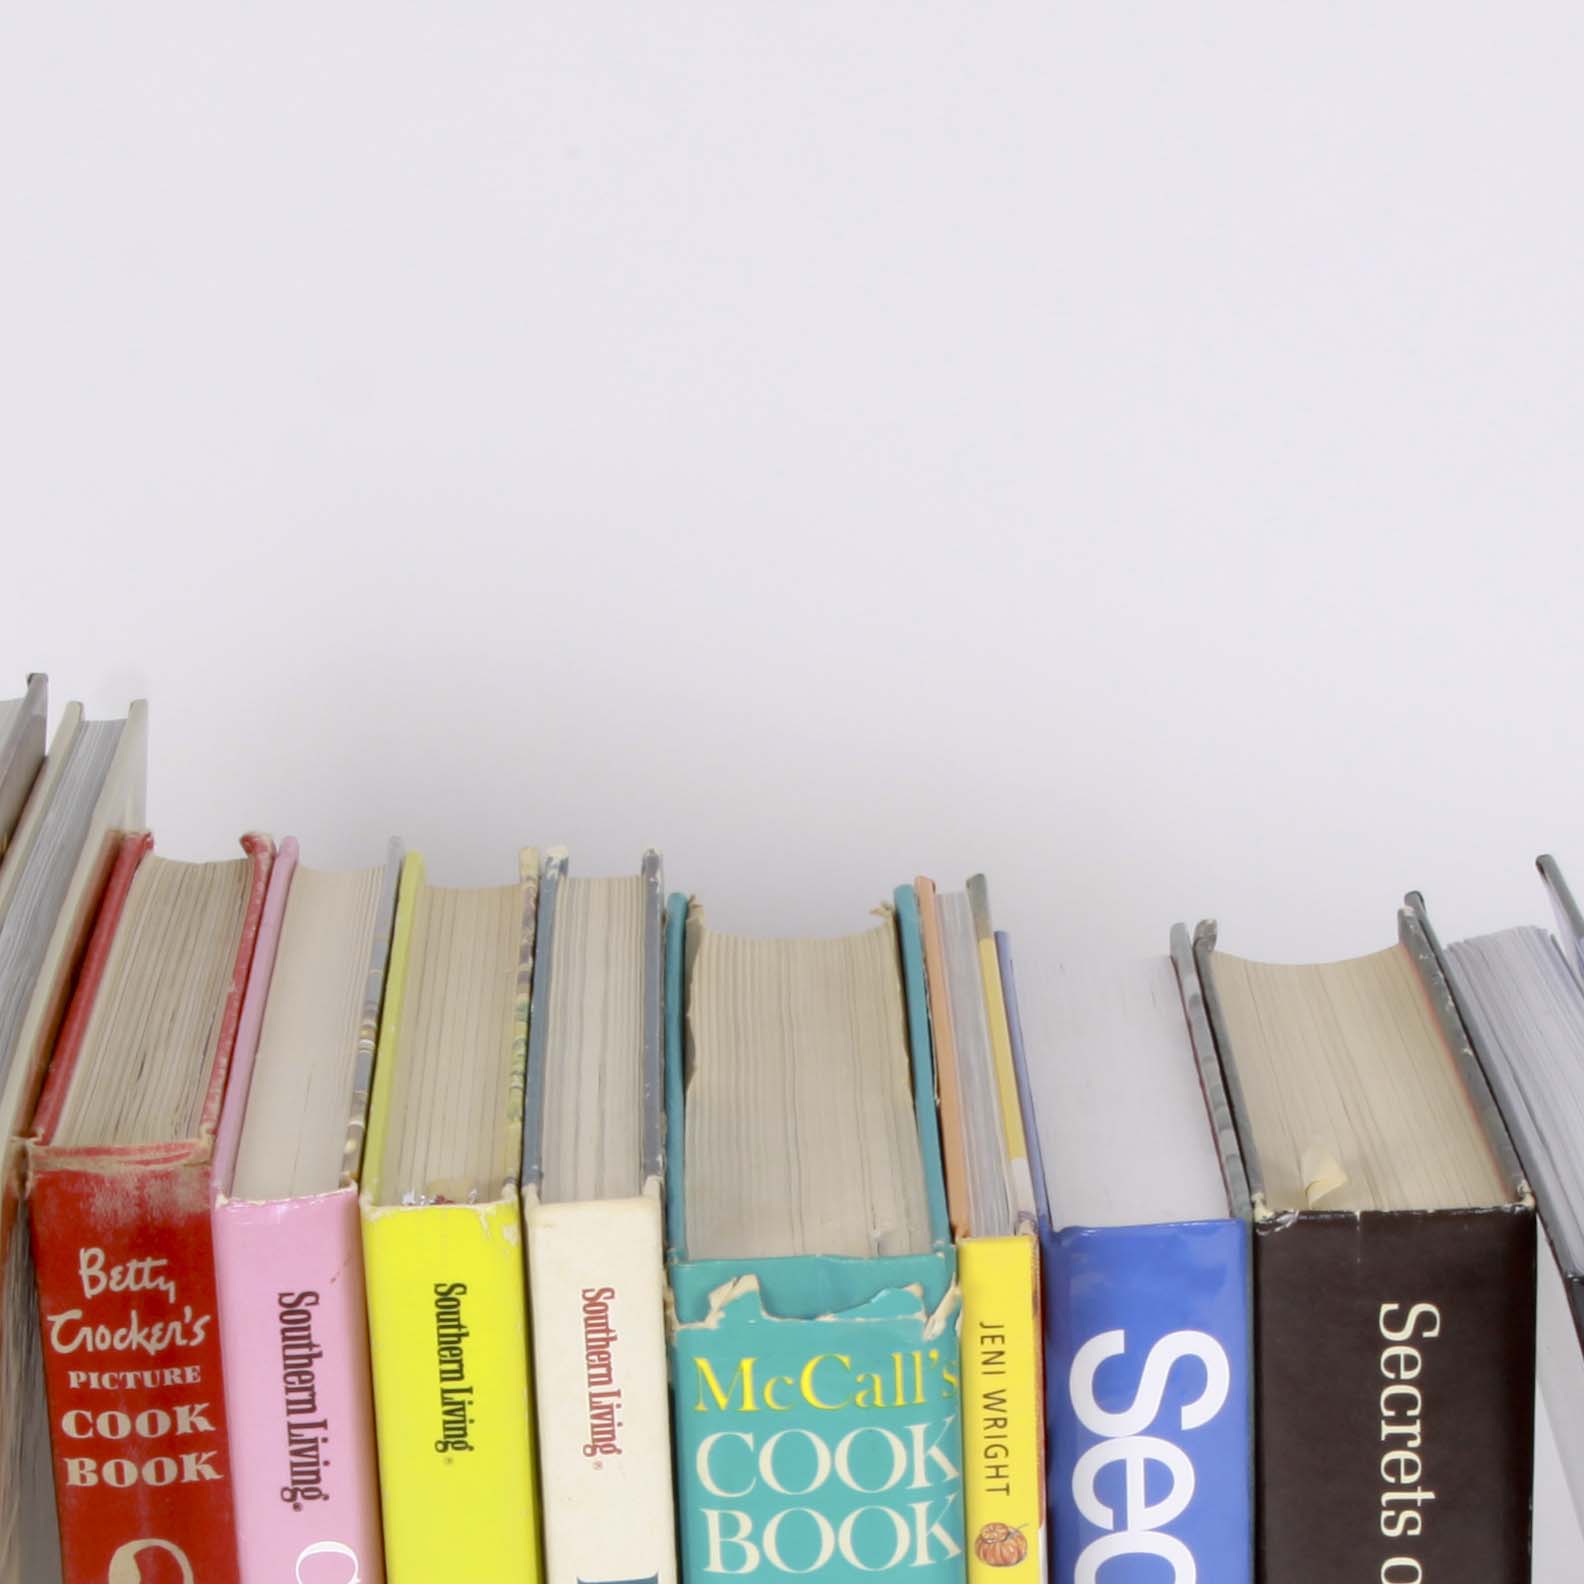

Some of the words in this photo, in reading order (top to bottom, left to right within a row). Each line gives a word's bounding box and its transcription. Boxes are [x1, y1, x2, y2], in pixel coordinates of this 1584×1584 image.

[78, 1247, 176, 1304] Betty
[47, 1305, 211, 1356] Crocker's
[277, 1290, 324, 1419] Southern
[433, 1281, 471, 1382] Southern
[582, 1287, 618, 1385] Southern
[979, 1322, 1004, 1377] JENI
[67, 1365, 201, 1390] PICTURE
[693, 1349, 958, 1412] McCall's
[61, 1402, 216, 1440] COOK
[434, 1386, 474, 1453] Living
[583, 1388, 623, 1457] Living
[982, 1389, 1011, 1497] WRIGHT
[1379, 1302, 1441, 1537] Secrets
[64, 1450, 224, 1488] BOOK
[696, 1415, 959, 1498] COOK
[700, 1492, 962, 1574] BOOK
